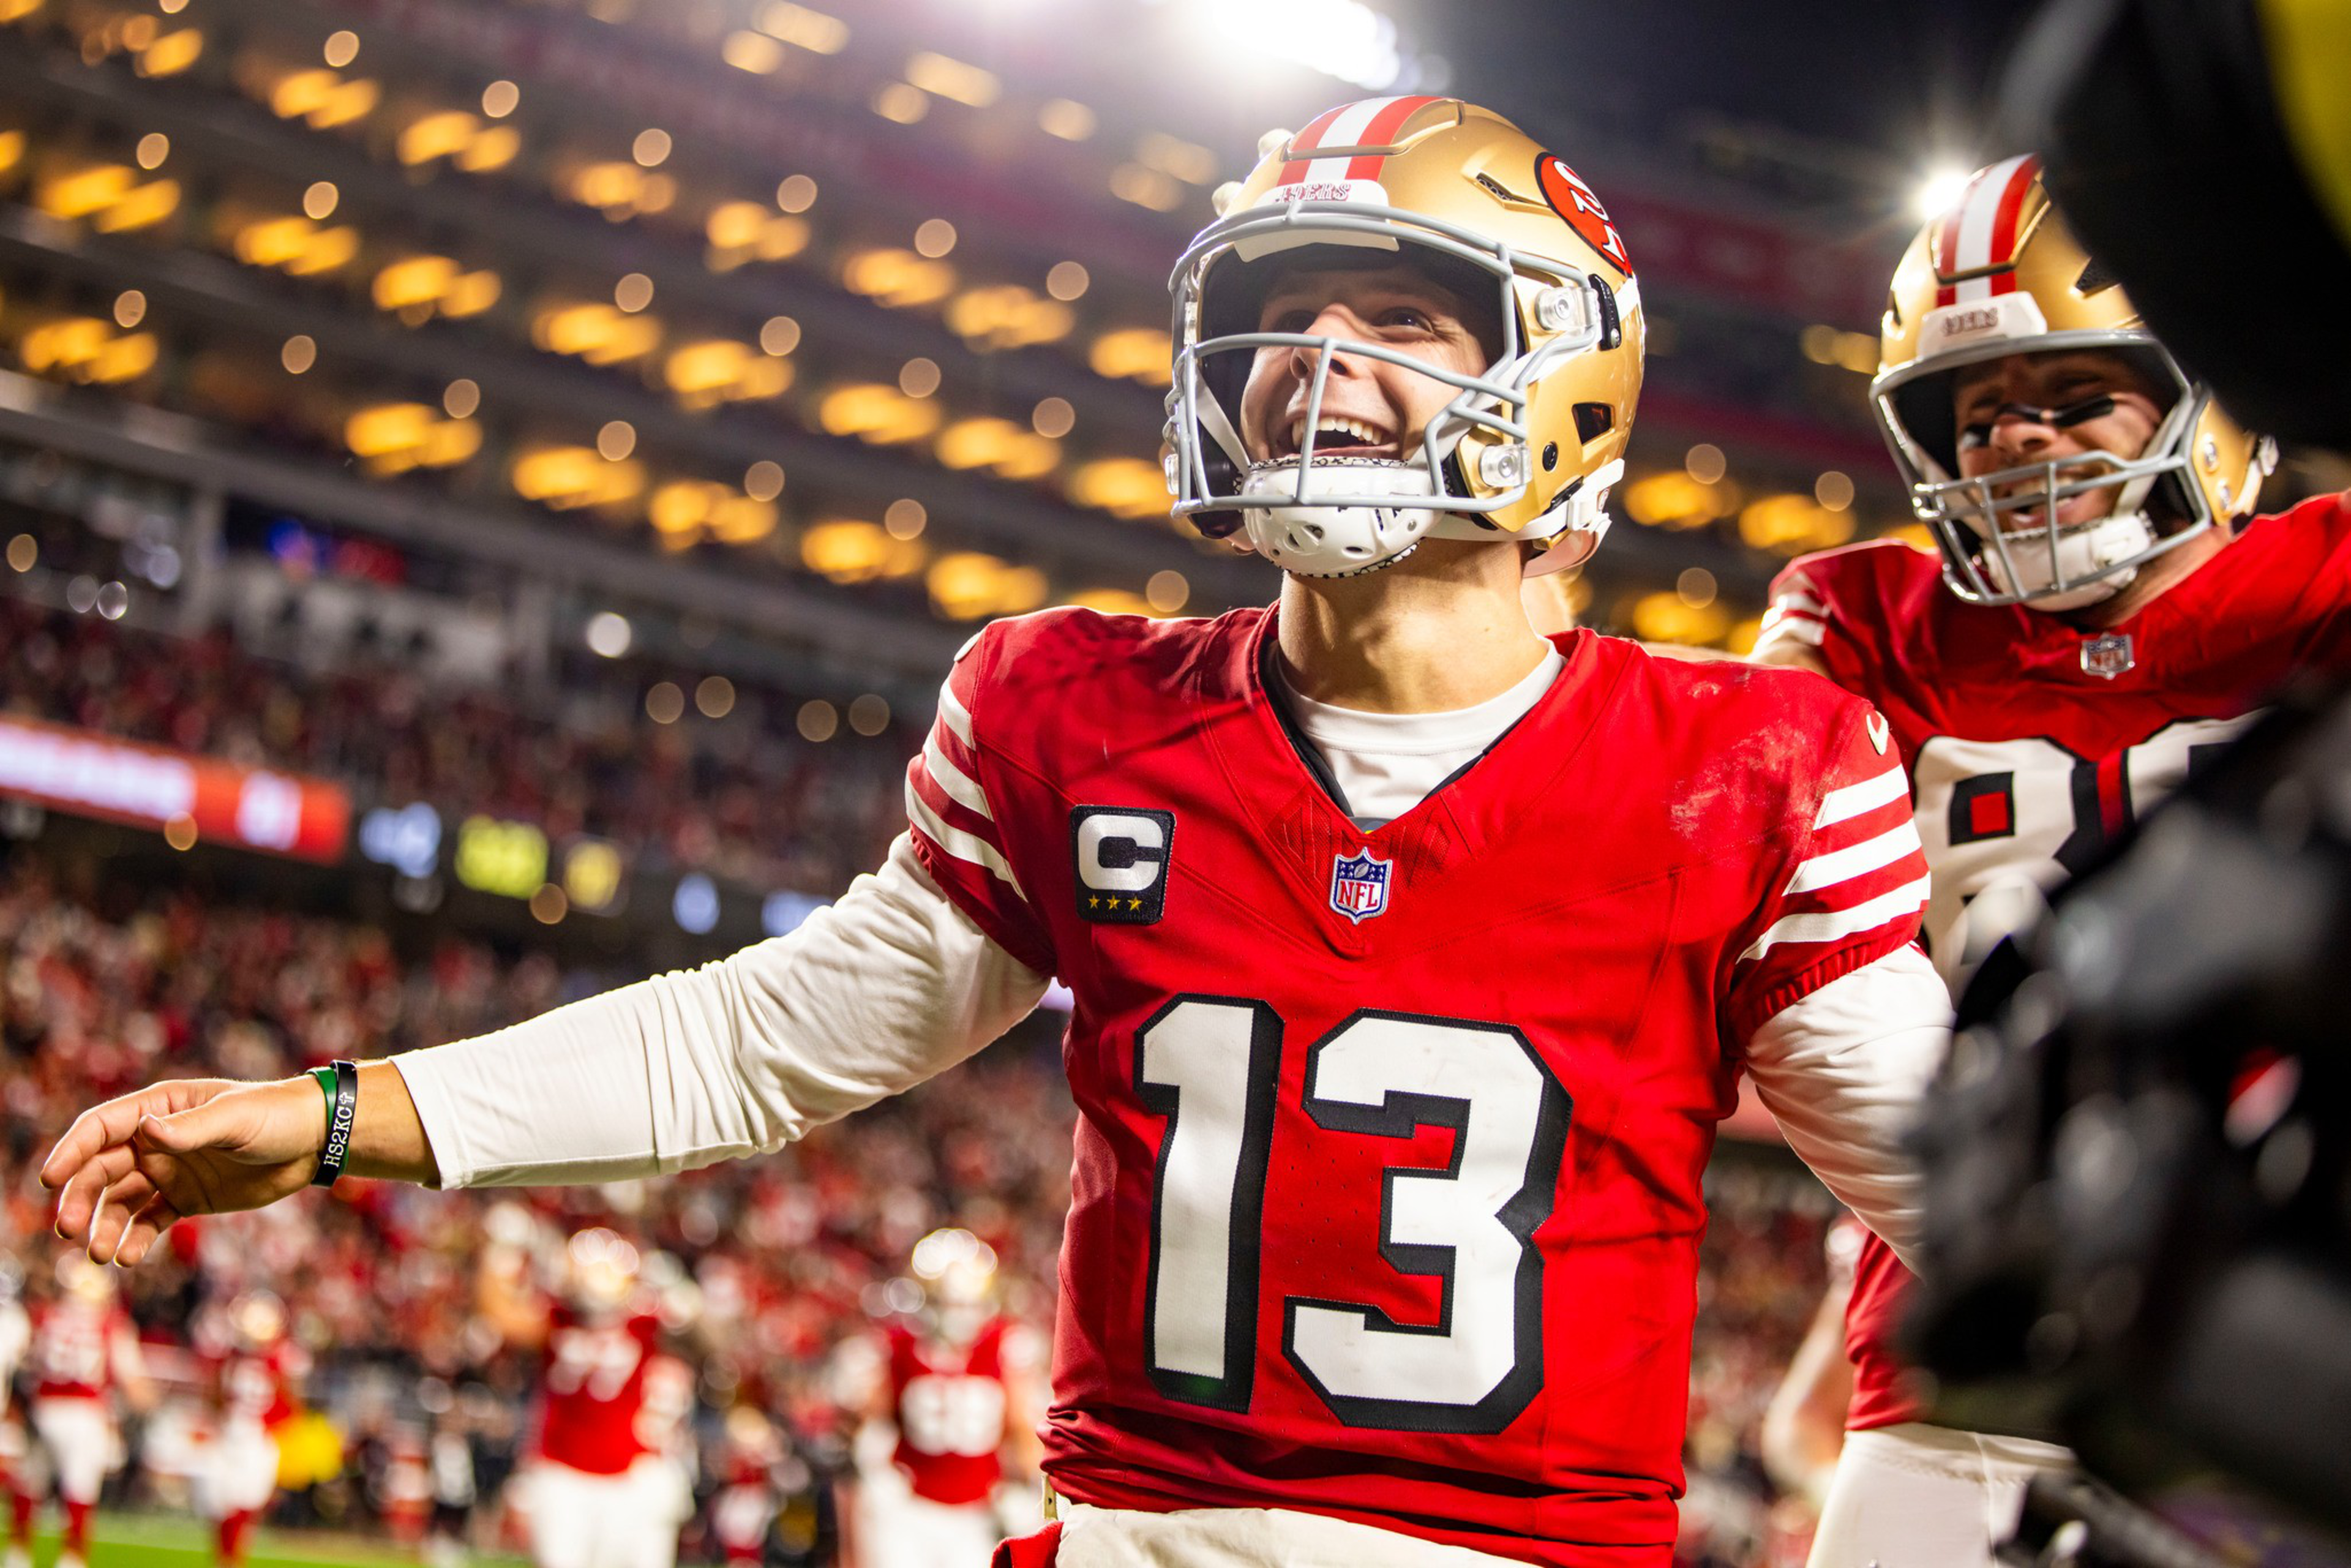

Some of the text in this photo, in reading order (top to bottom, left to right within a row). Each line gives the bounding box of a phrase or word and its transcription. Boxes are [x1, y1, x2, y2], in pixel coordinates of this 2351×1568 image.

[1078, 814, 1163, 891] C
[1338, 880, 1378, 910] NFL
[1133, 992, 1573, 1435] 13
